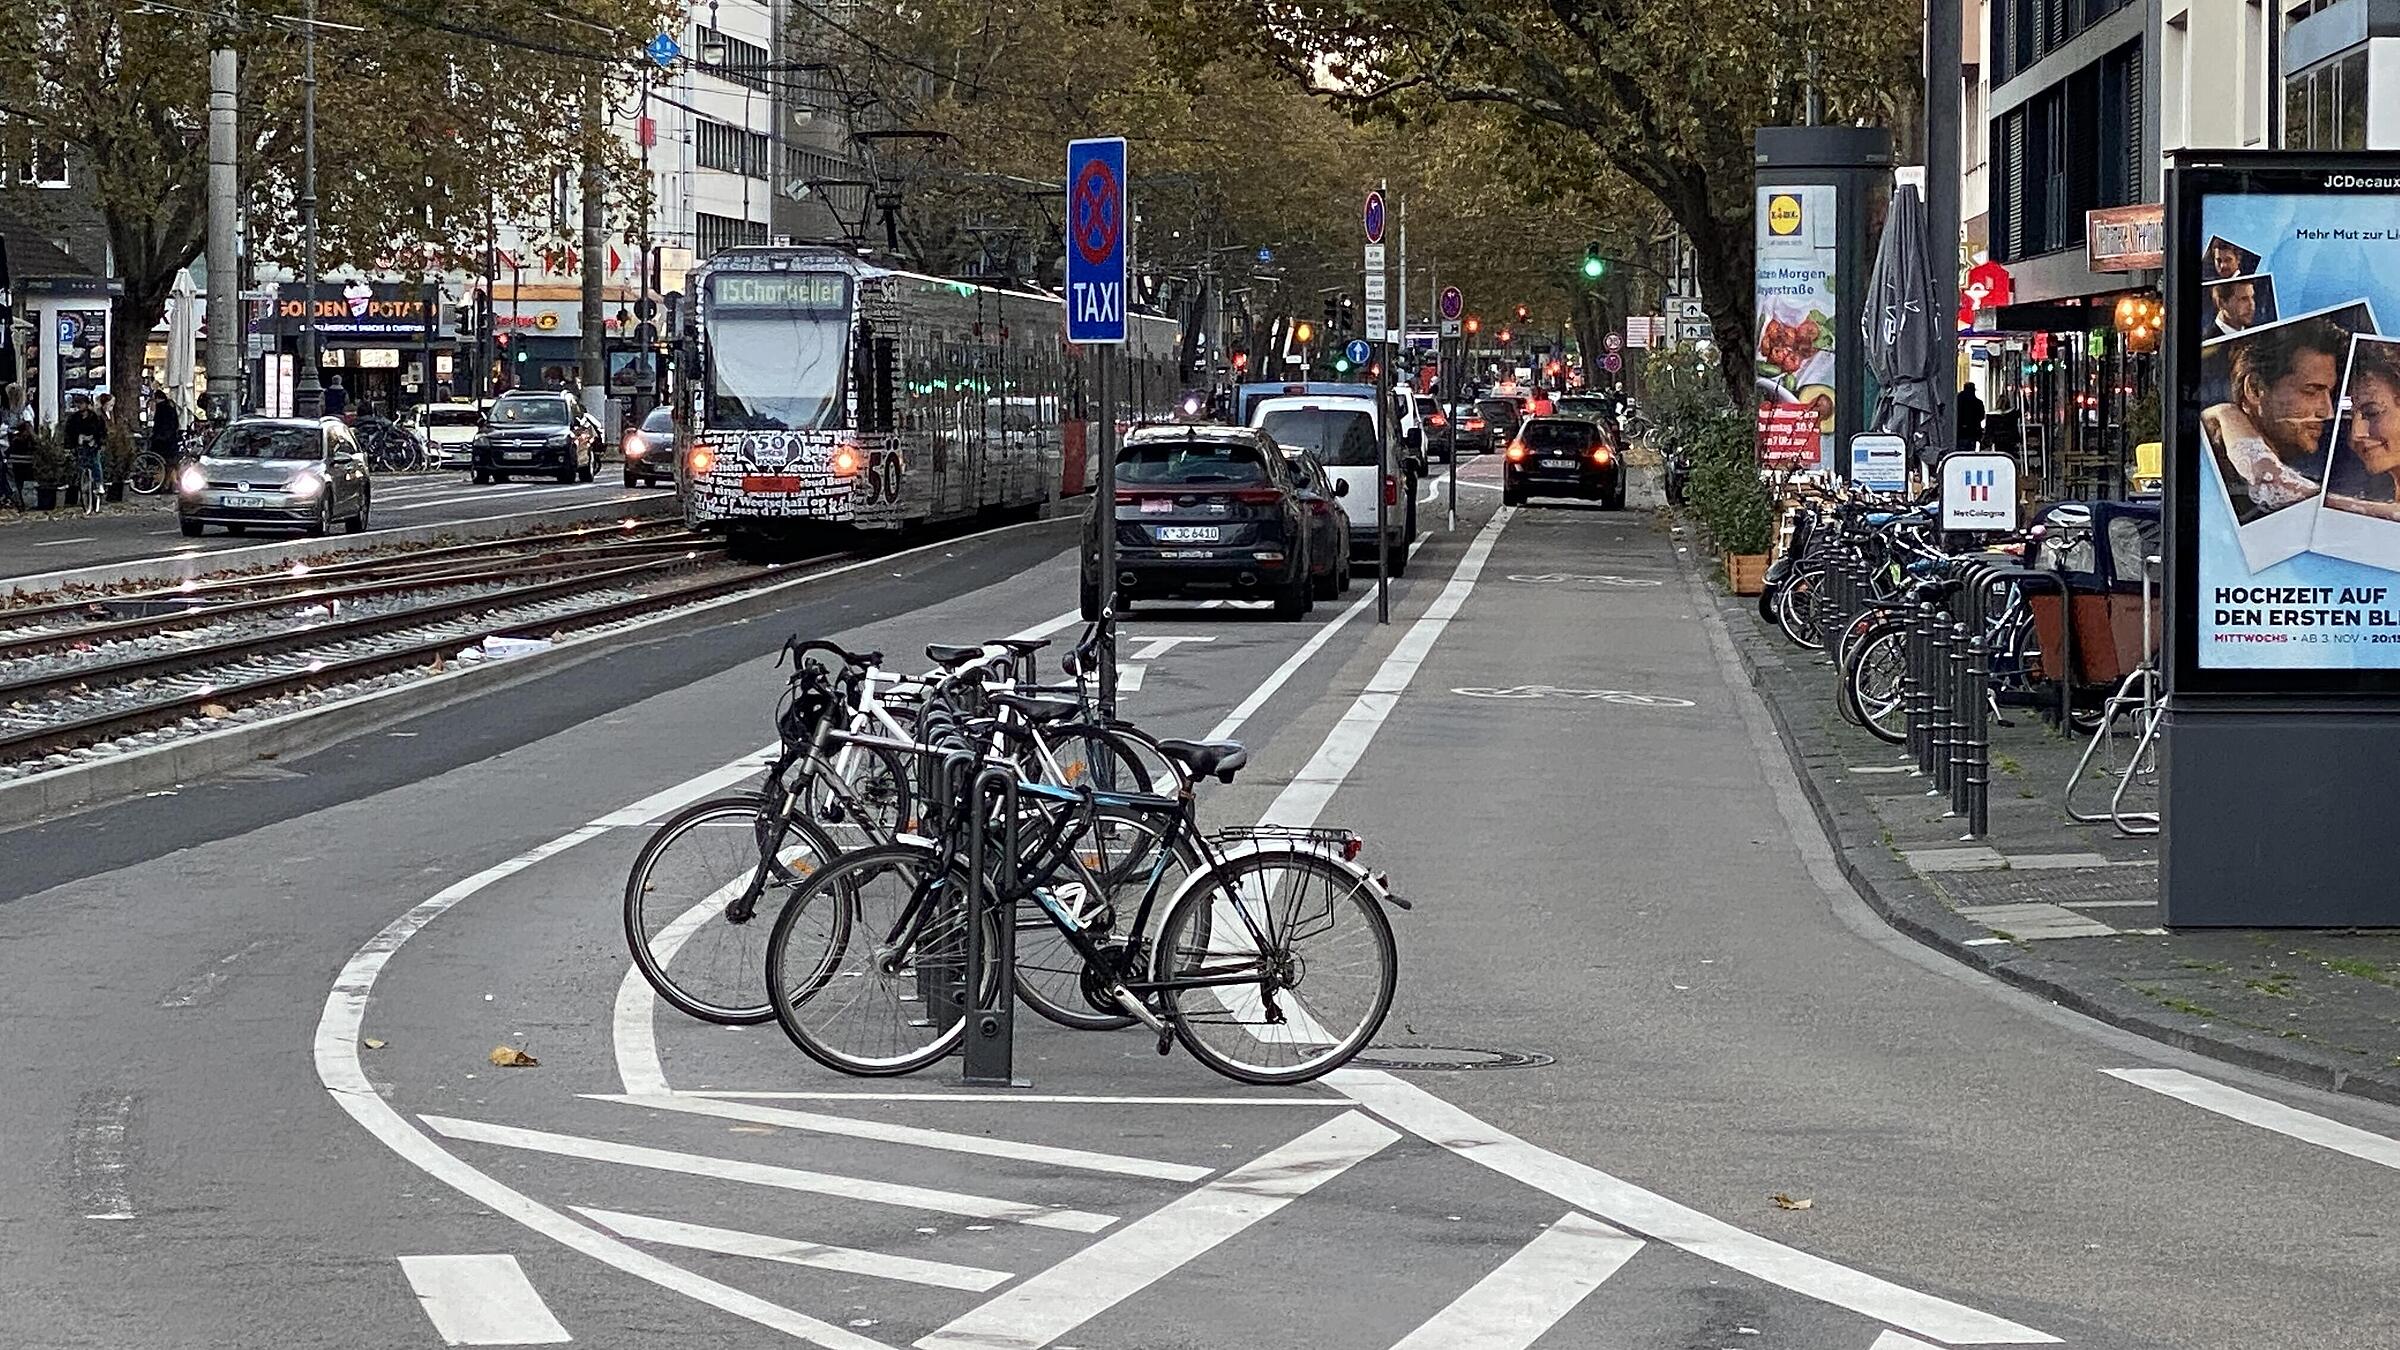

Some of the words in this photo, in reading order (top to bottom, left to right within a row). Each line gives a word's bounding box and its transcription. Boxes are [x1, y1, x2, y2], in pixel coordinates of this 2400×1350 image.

[2323, 175, 2400, 188] JCDecaux
[2296, 228, 2330, 240] Mehr
[2333, 228, 2360, 240] Mut
[2363, 231, 2384, 240] zur
[2387, 228, 2400, 240] Li
[721, 280, 741, 301] 15
[742, 278, 844, 302] Chorweiler
[1073, 282, 1120, 323] TAXI
[1952, 509, 2006, 519] NetCologne
[2215, 587, 2334, 604] HOCHZEIT
[2338, 587, 2388, 604] AUF
[2214, 609, 2262, 626] DEN
[2269, 609, 2361, 626] ERSTEN
[2214, 633, 2288, 643] MITTWOCHS
[2300, 633, 2318, 643] AB
[2321, 633, 2330, 643] 3
[2334, 633, 2360, 643] NOV
